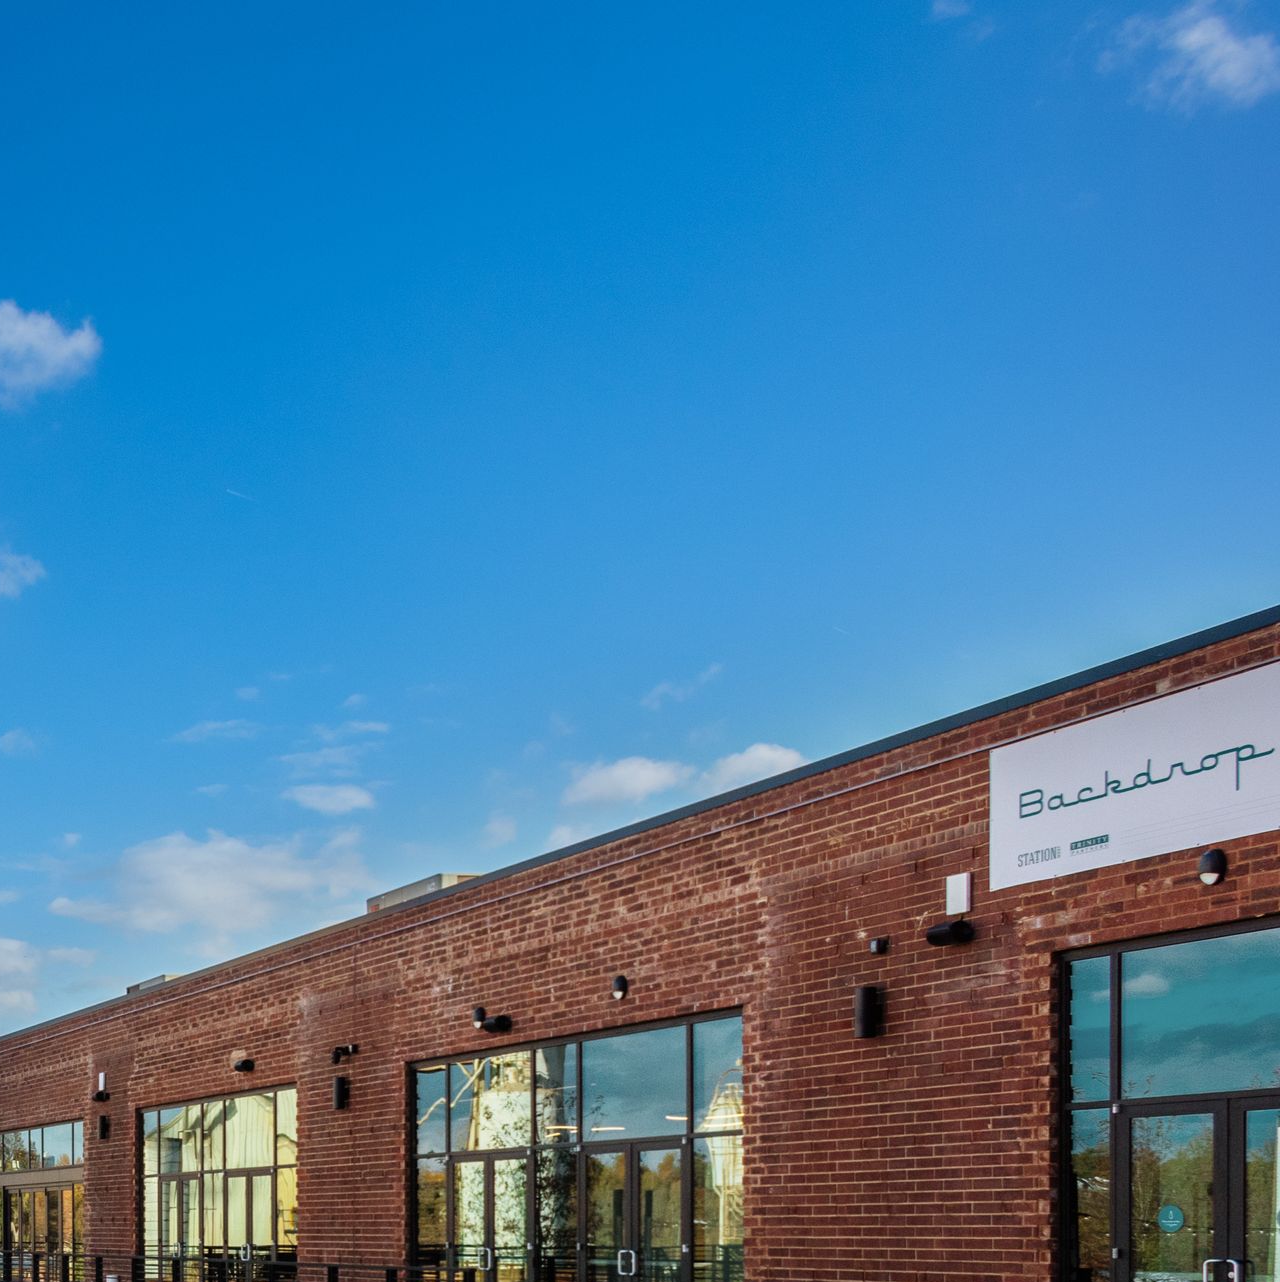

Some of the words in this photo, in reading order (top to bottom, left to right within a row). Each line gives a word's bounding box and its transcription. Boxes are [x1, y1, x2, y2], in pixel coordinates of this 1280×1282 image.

[1019, 744, 1276, 819] Backdrop
[1071, 836, 1108, 850] TRINITY
[1017, 846, 1057, 868] STATION
